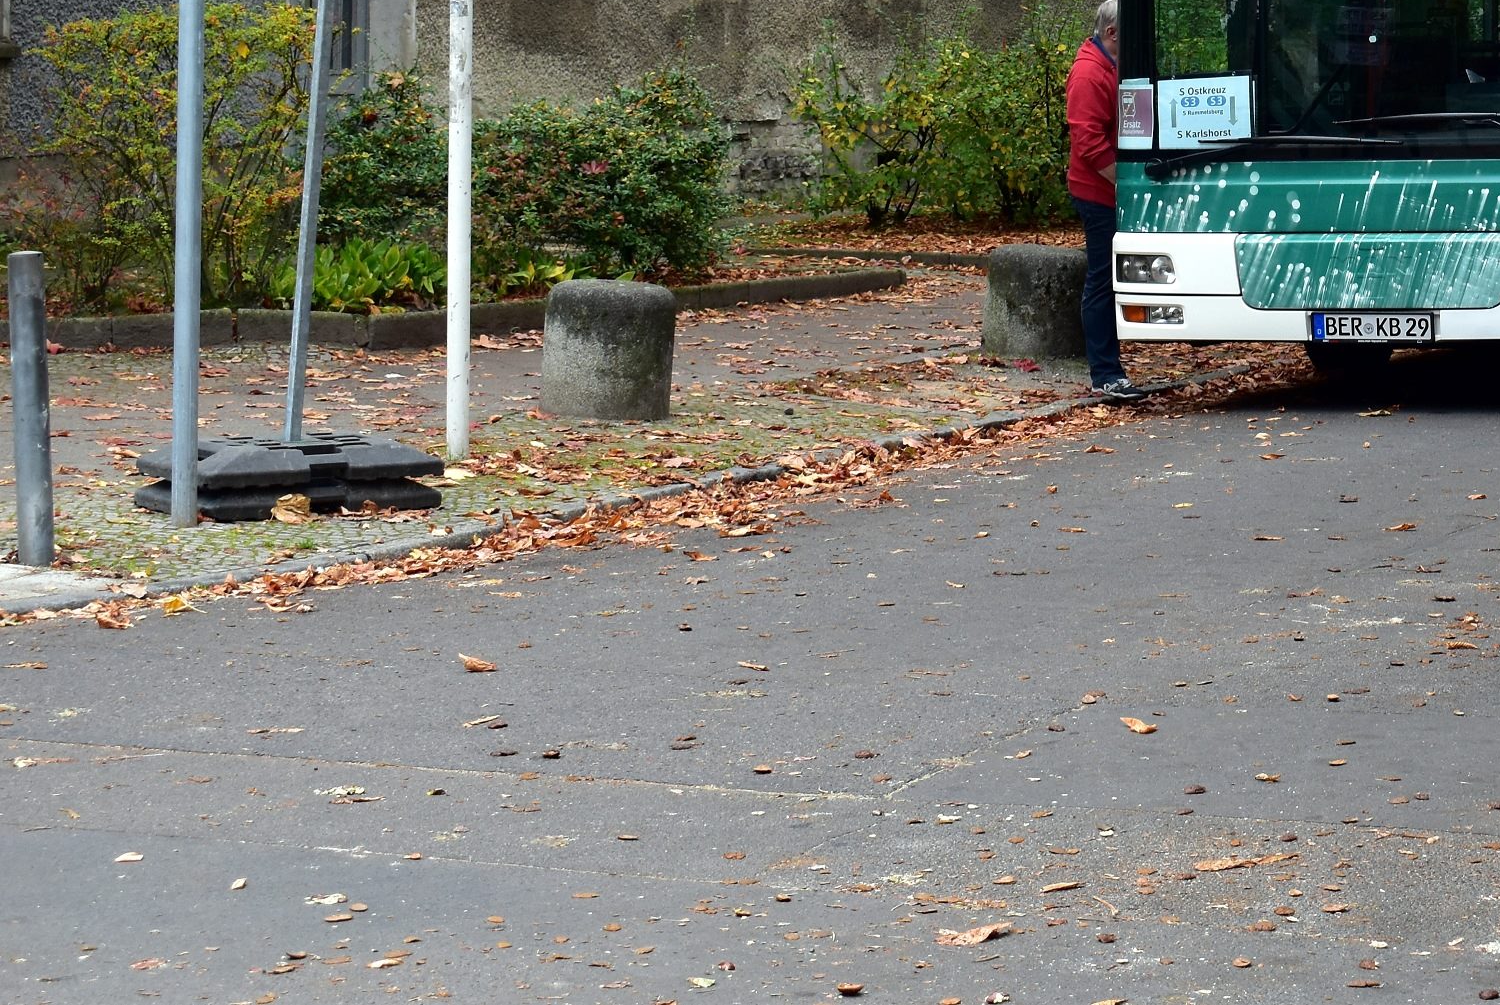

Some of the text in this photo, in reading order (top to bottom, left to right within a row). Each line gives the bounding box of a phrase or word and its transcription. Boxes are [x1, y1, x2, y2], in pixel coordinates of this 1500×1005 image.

[1179, 87, 1226, 96] S Ostkreuz
[1123, 120, 1141, 129] Ersatz
[1177, 128, 1232, 138] S Karlshorst
[1325, 317, 1363, 337] BER
[1376, 317, 1401, 337] KB
[1405, 317, 1429, 337] 29
